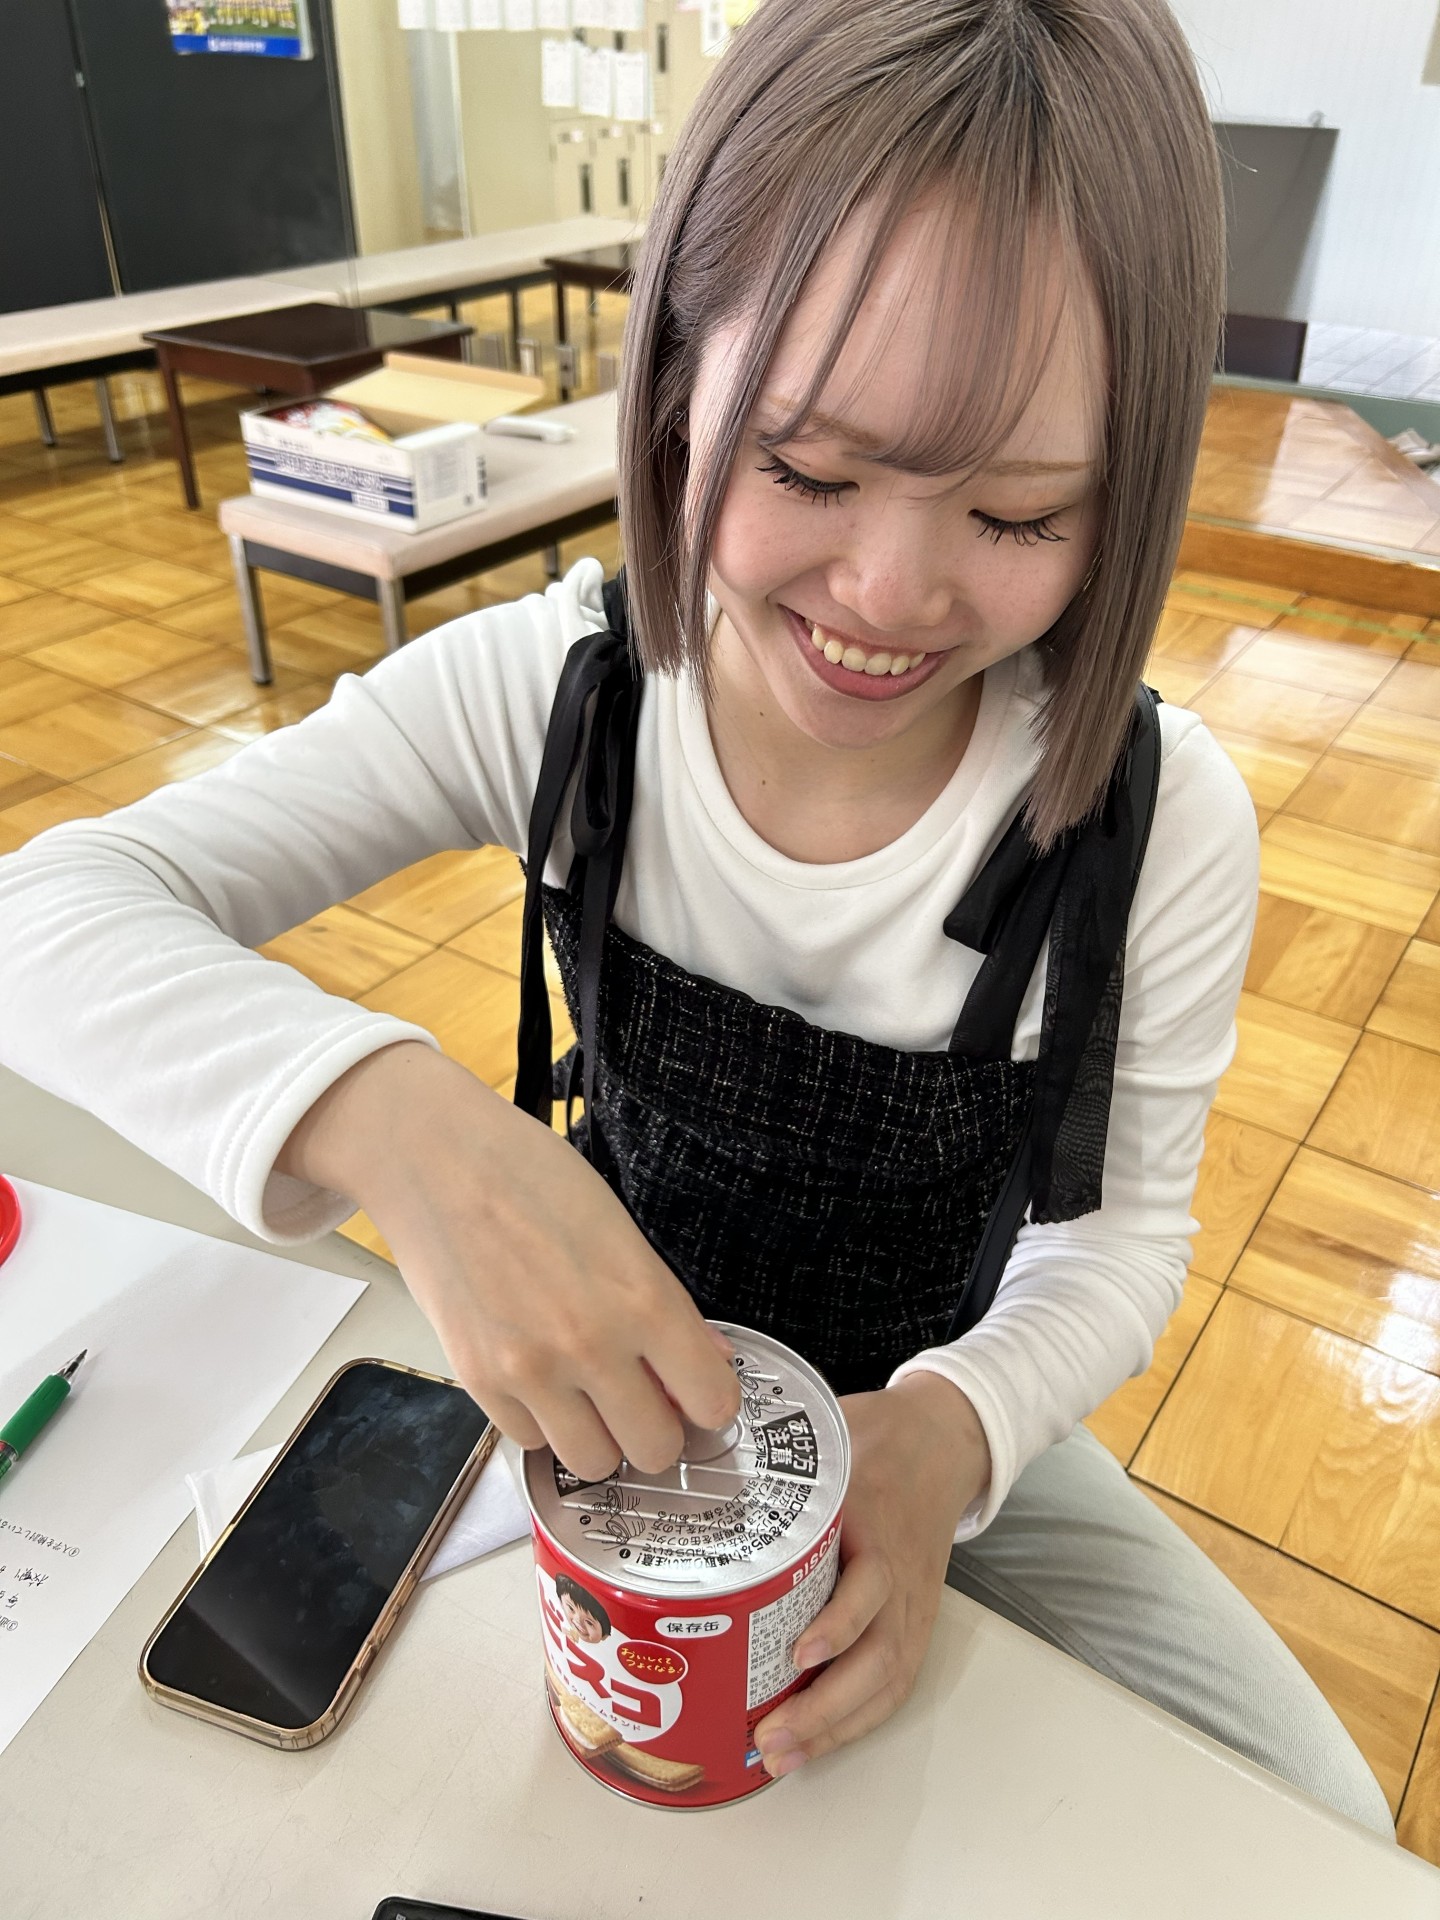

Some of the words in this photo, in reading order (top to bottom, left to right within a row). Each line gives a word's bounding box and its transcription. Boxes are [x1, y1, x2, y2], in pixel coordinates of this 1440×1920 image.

[766, 1426, 793, 1466] 注意
[787, 1418, 816, 1473] あけ方
[792, 1527, 836, 1587] BISCO
[666, 1620, 720, 1634] 保存缶
[620, 1647, 672, 1665] おいしくて
